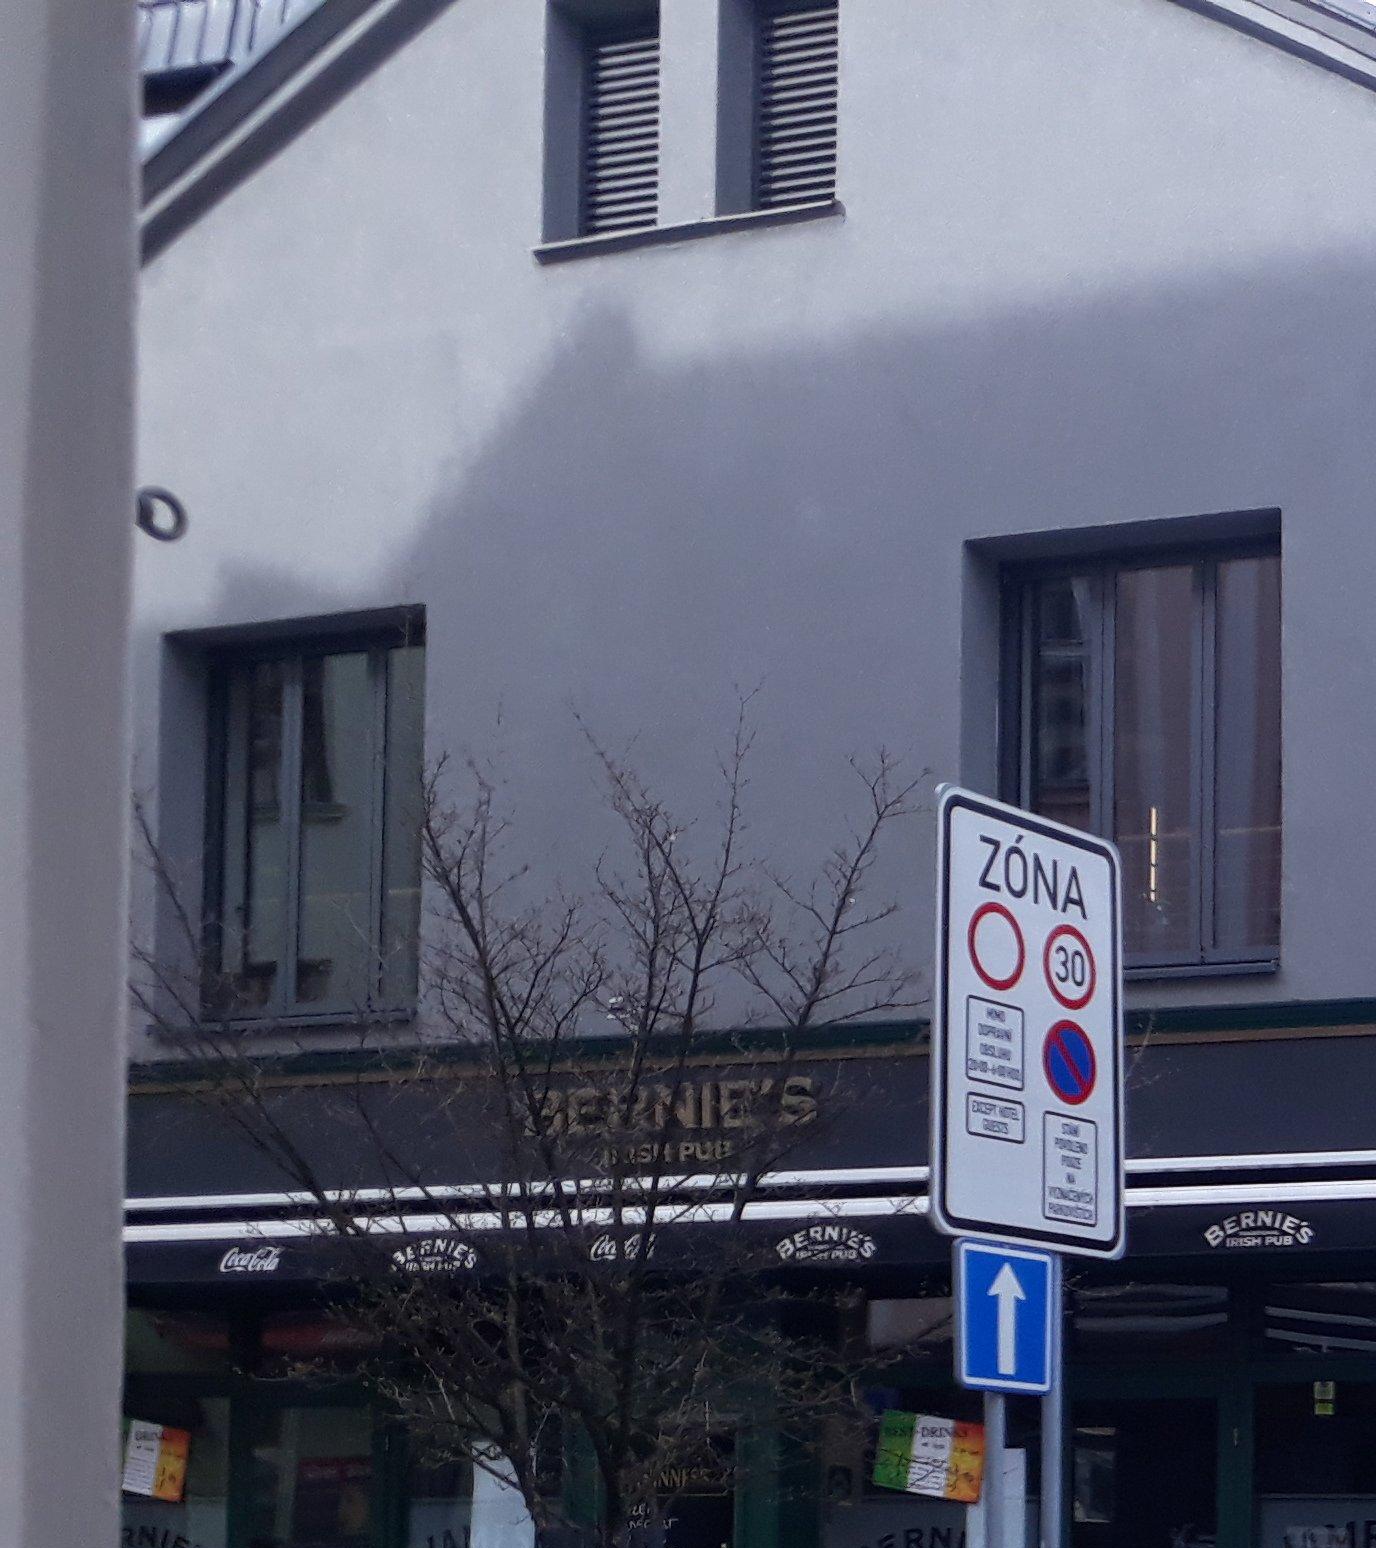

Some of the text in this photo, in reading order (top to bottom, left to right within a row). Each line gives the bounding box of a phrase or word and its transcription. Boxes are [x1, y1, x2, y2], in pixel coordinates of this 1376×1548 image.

[979, 834, 1088, 920] ZÓNA
[1055, 946, 1085, 986] 30
[1203, 1210, 1315, 1248] BERNIE'S
[1226, 1235, 1293, 1247] IRISH PUB
